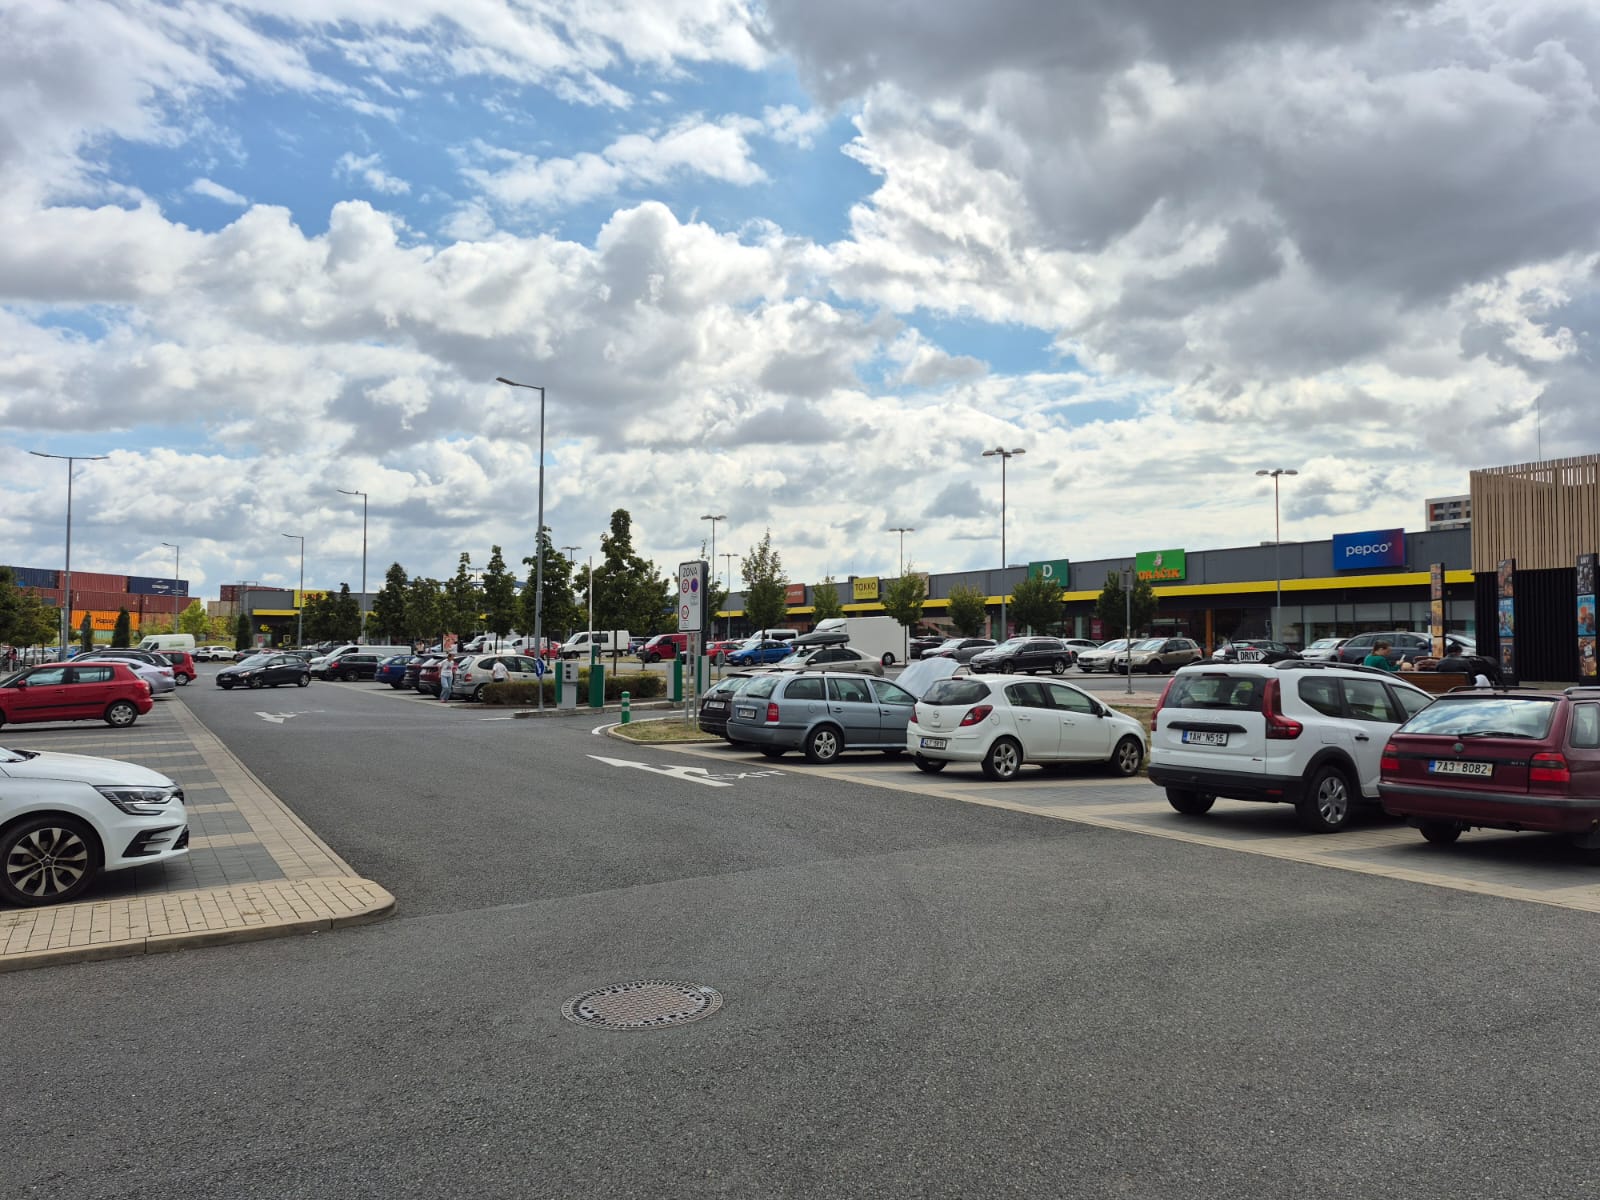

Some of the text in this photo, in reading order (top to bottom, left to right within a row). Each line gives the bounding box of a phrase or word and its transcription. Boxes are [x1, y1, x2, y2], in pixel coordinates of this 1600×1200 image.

[1345, 543, 1389, 557] pepco
[682, 567, 698, 578] ZONA
[1042, 564, 1053, 578] D
[855, 583, 876, 591] TOKKO
[1240, 651, 1259, 661] DRIVE
[1189, 732, 1224, 743] 1AH N515
[1437, 761, 1488, 774] 7A3 8082
